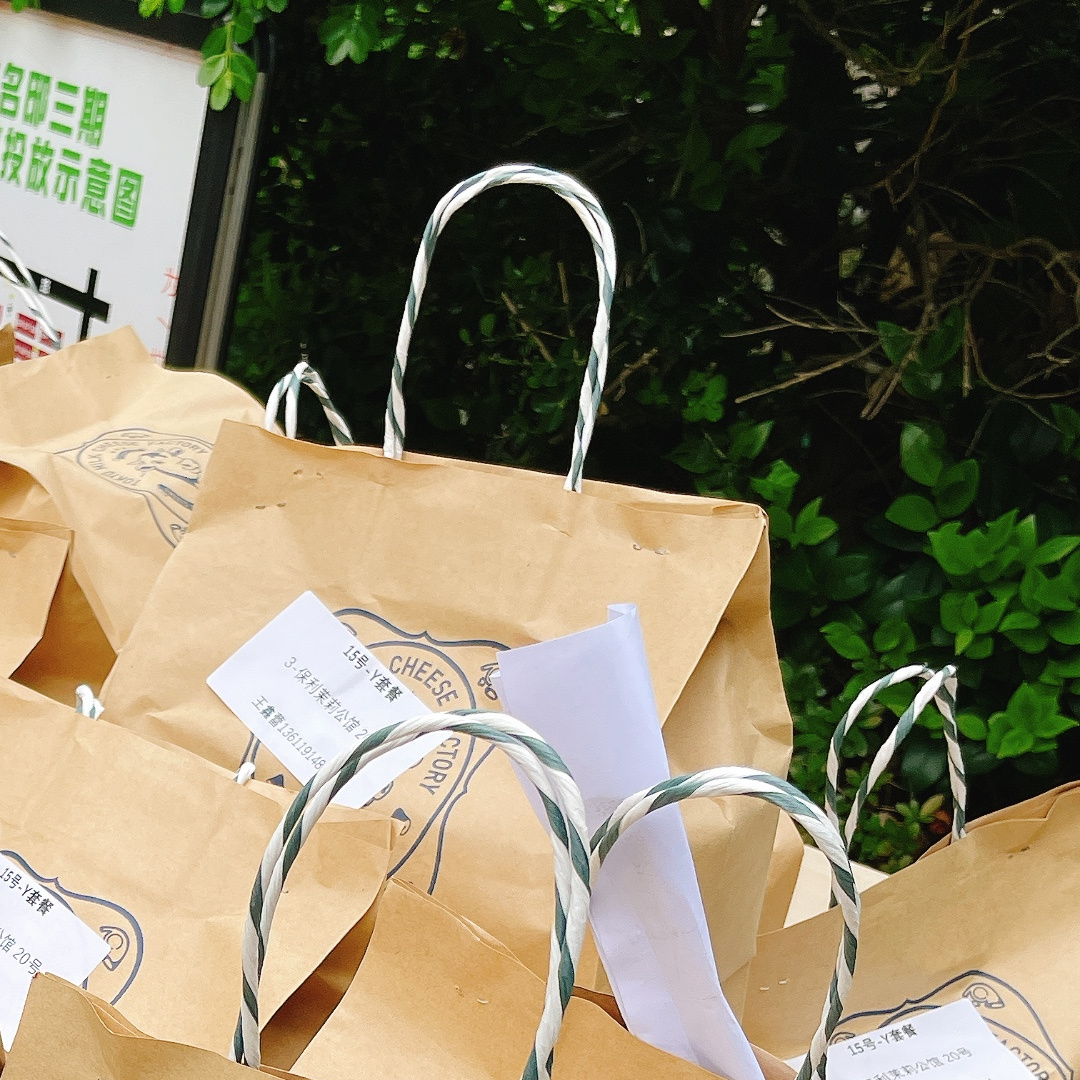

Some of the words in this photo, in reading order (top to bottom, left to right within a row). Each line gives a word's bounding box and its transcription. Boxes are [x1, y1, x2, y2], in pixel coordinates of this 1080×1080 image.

[284, 656, 361, 733] 3-保利茉莉公馆
[342, 645, 404, 702] 15号-Y套餐
[389, 655, 459, 707] CHEESE
[419, 737, 461, 795] CTORY
[12, 947, 43, 975] 20号
[847, 1023, 918, 1056] 15号-Y套餐
[943, 1047, 973, 1063] 20号
